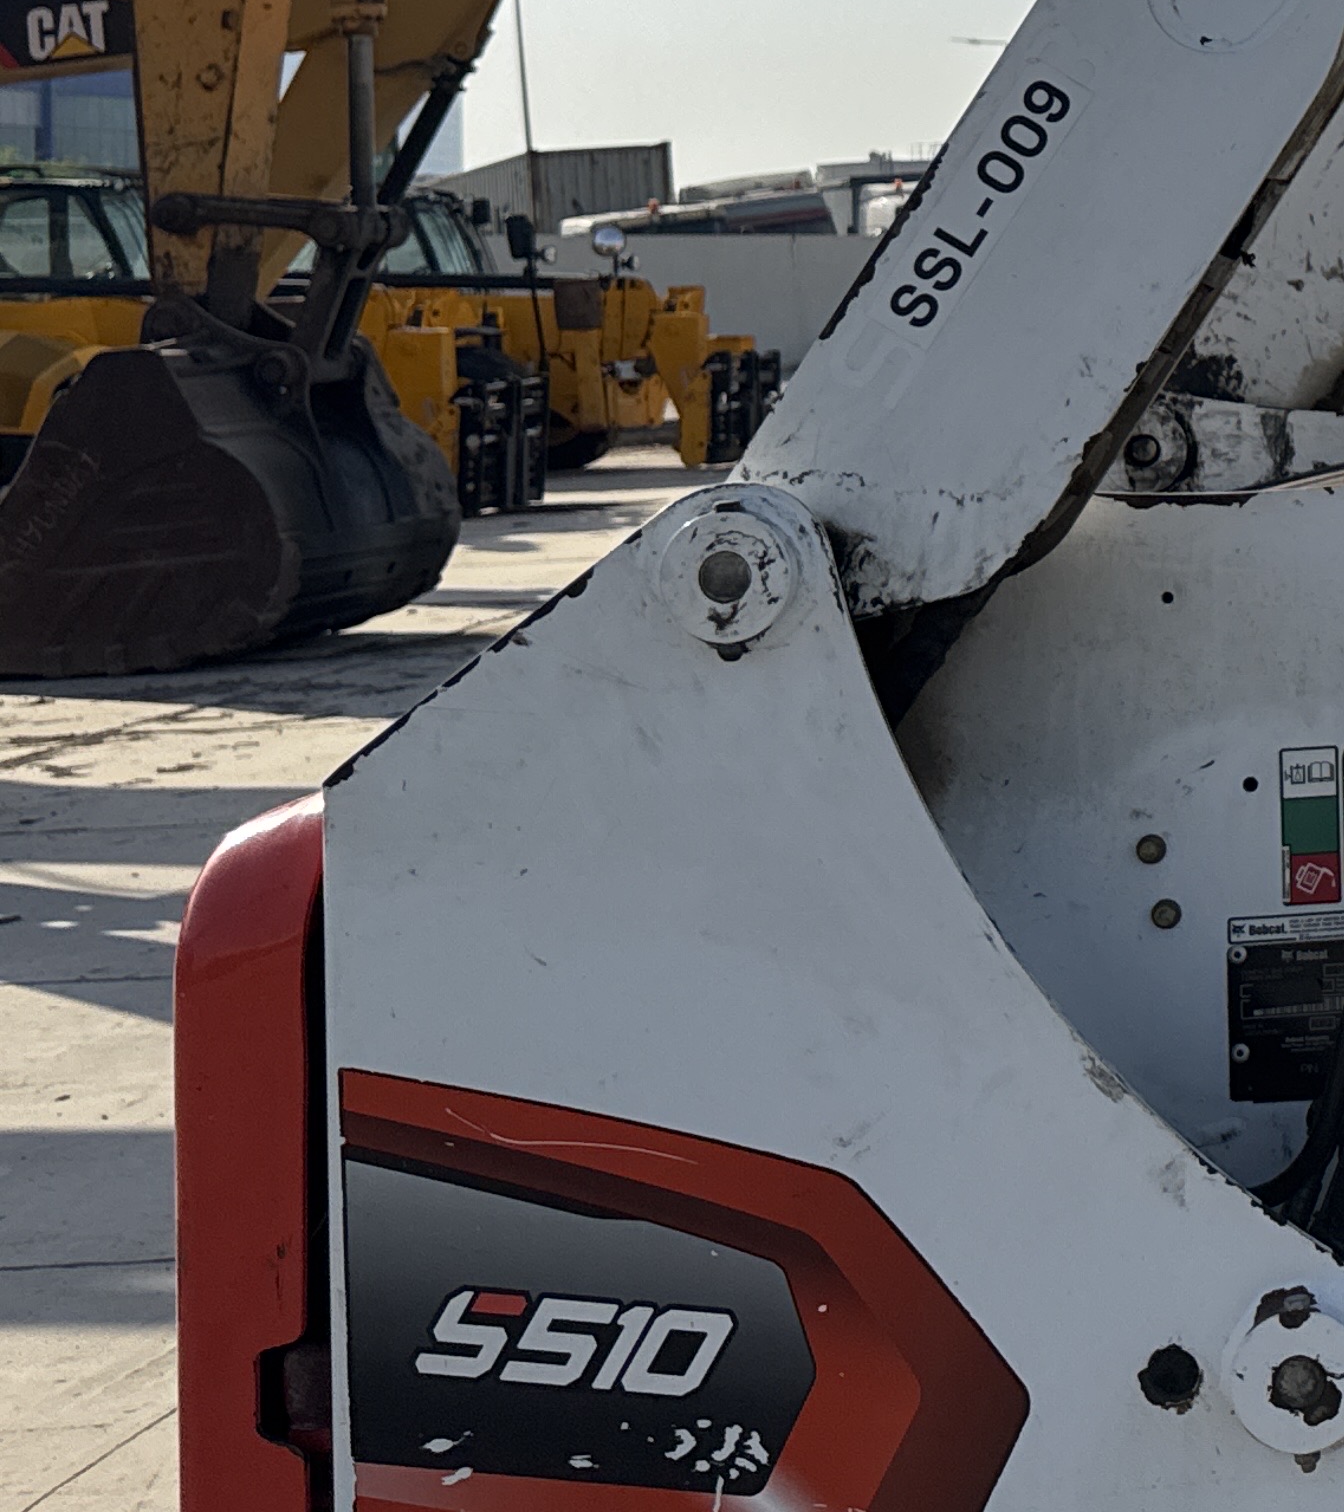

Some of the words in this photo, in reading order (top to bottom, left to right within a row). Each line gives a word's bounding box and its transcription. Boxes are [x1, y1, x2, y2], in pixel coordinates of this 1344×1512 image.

[889, 79, 1071, 328] SSL-009
[1249, 922, 1285, 936] Bobcat
[414, 1290, 735, 1396] S510
